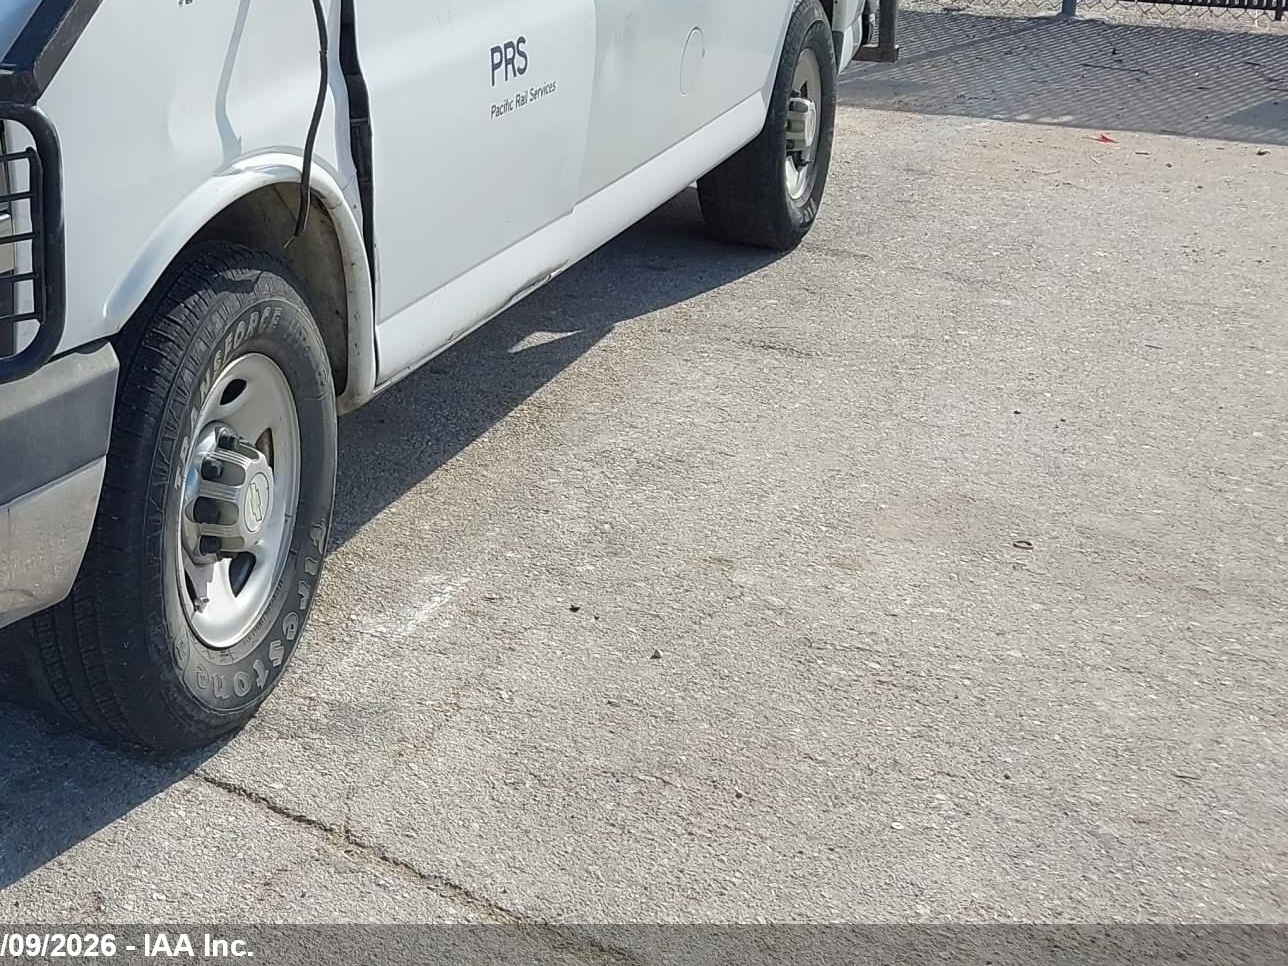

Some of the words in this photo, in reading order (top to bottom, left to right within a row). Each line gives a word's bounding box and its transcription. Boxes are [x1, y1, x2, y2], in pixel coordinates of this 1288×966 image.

[490, 36, 528, 87] PRS
[491, 99, 514, 121] Pacific
[516, 90, 529, 110] Rail
[530, 81, 557, 103] Services
